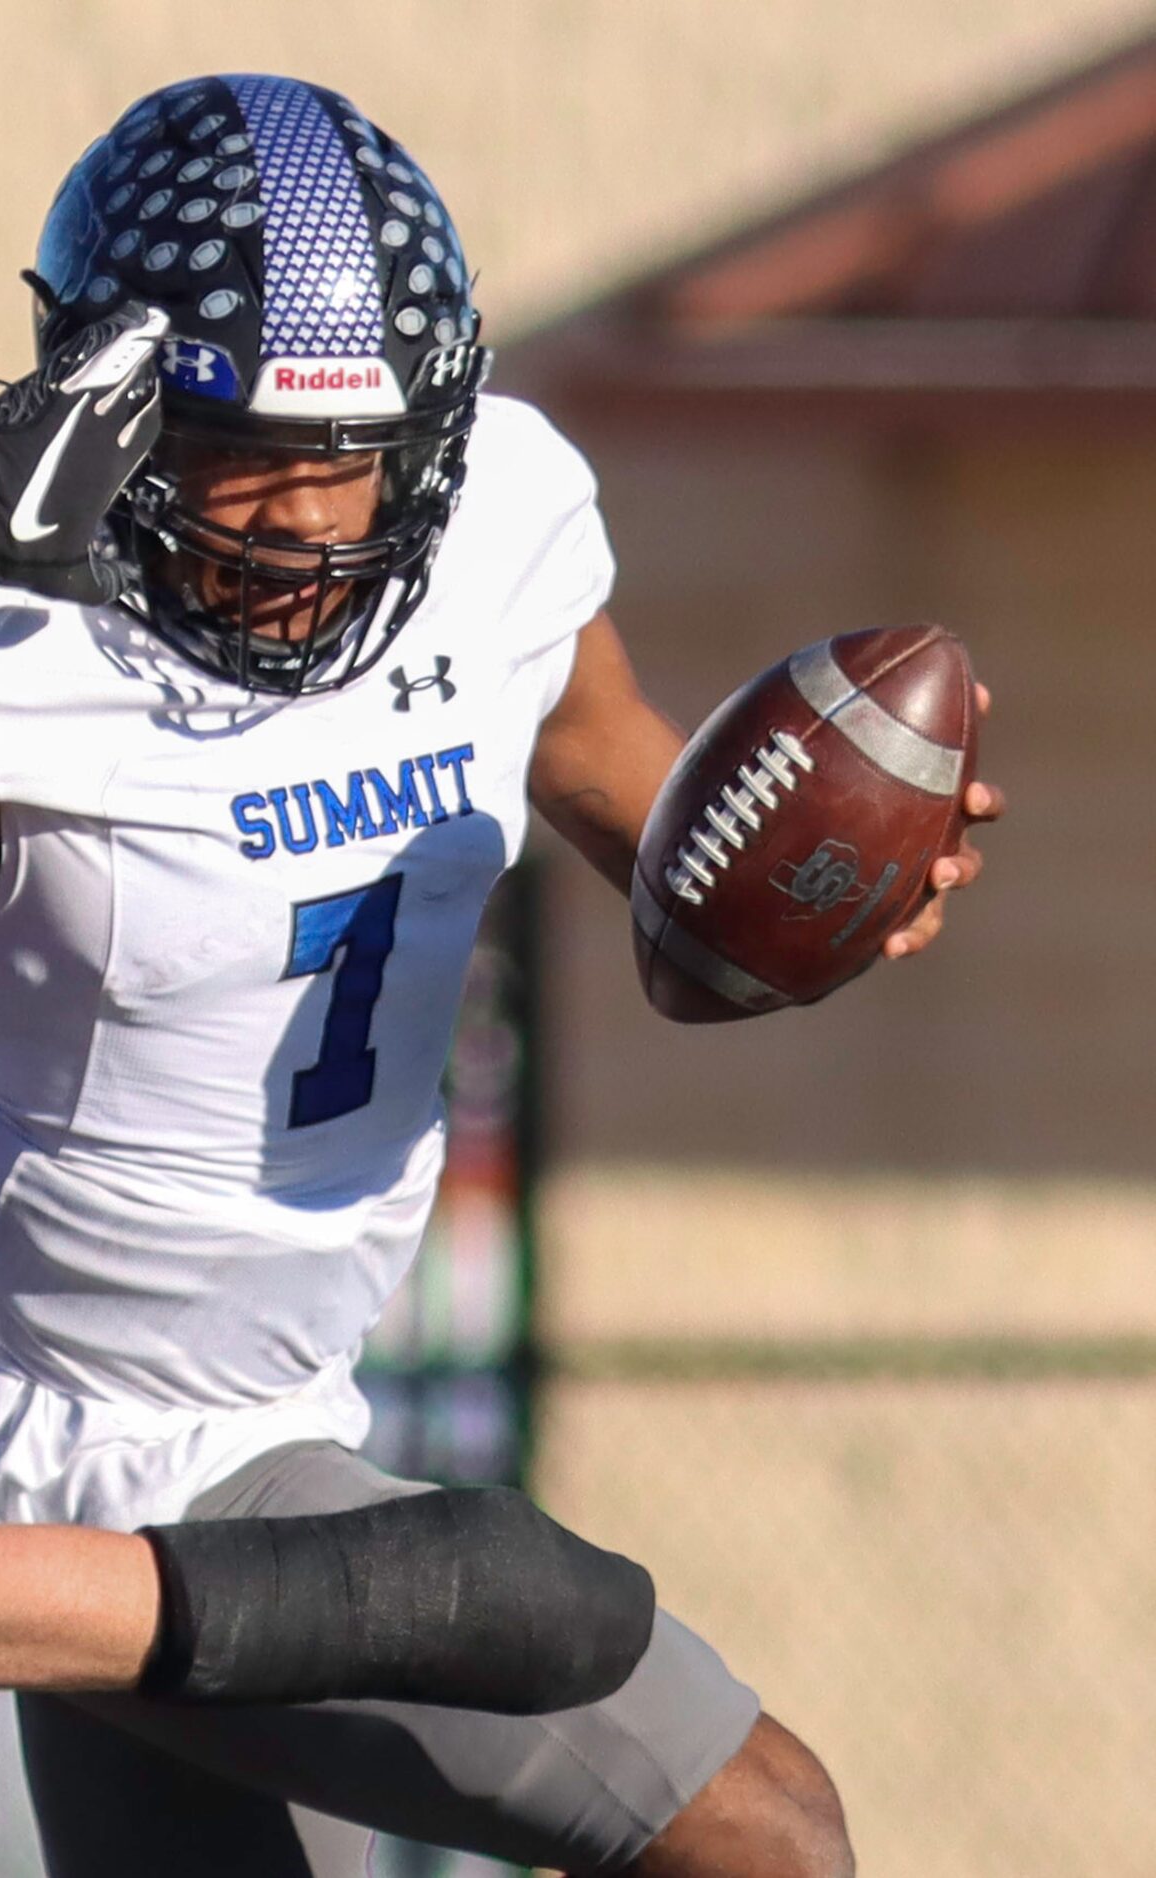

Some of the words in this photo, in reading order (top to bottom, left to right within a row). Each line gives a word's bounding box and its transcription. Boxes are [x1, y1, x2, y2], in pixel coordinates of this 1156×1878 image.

[274, 367, 381, 392] Riddell
[230, 742, 475, 860] SUMMIT
[277, 872, 404, 1130] 7
